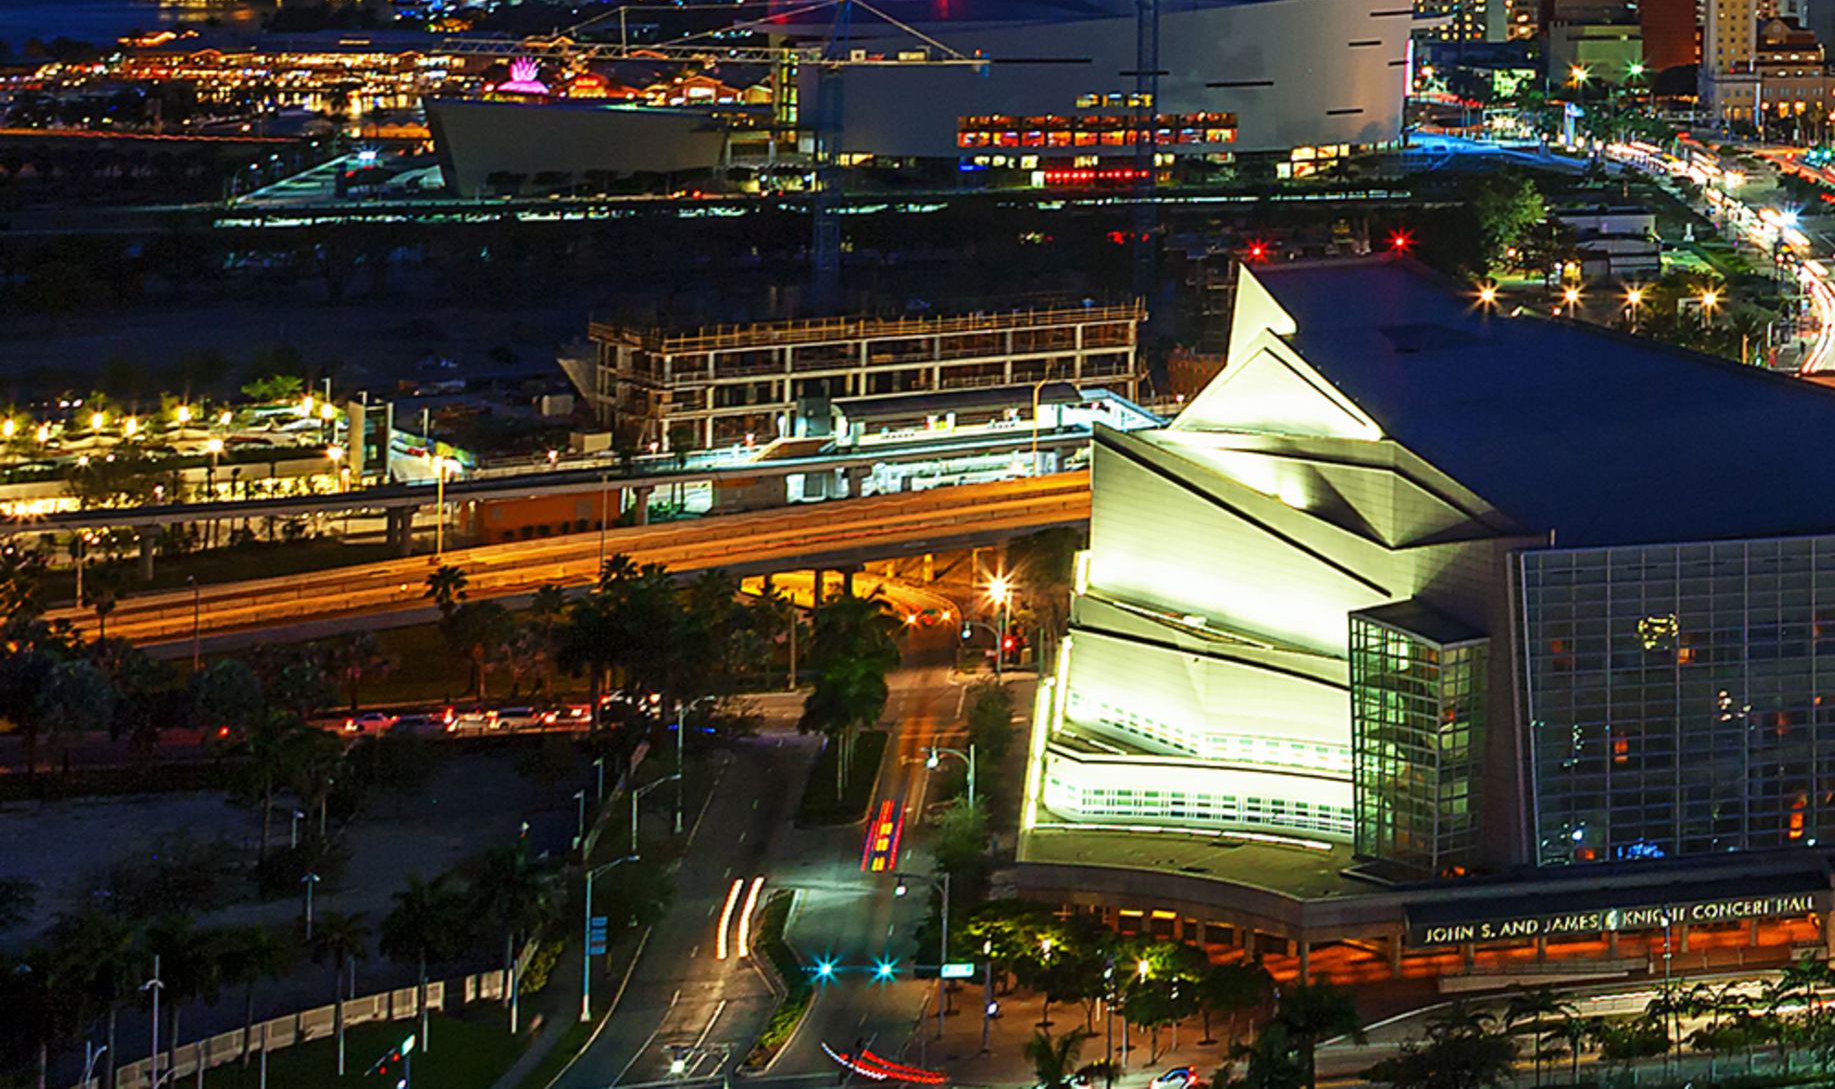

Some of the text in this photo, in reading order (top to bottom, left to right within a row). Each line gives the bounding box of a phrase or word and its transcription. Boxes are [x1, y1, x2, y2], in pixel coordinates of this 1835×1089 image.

[1425, 926, 1475, 943] JOHN
[1481, 923, 1496, 939] S.
[1500, 919, 1539, 936] AND
[1543, 913, 1599, 933] JAMES
[1623, 907, 1686, 926] KNIGHT
[1692, 899, 1772, 920] CONCERT
[1776, 895, 1815, 913] HALL
